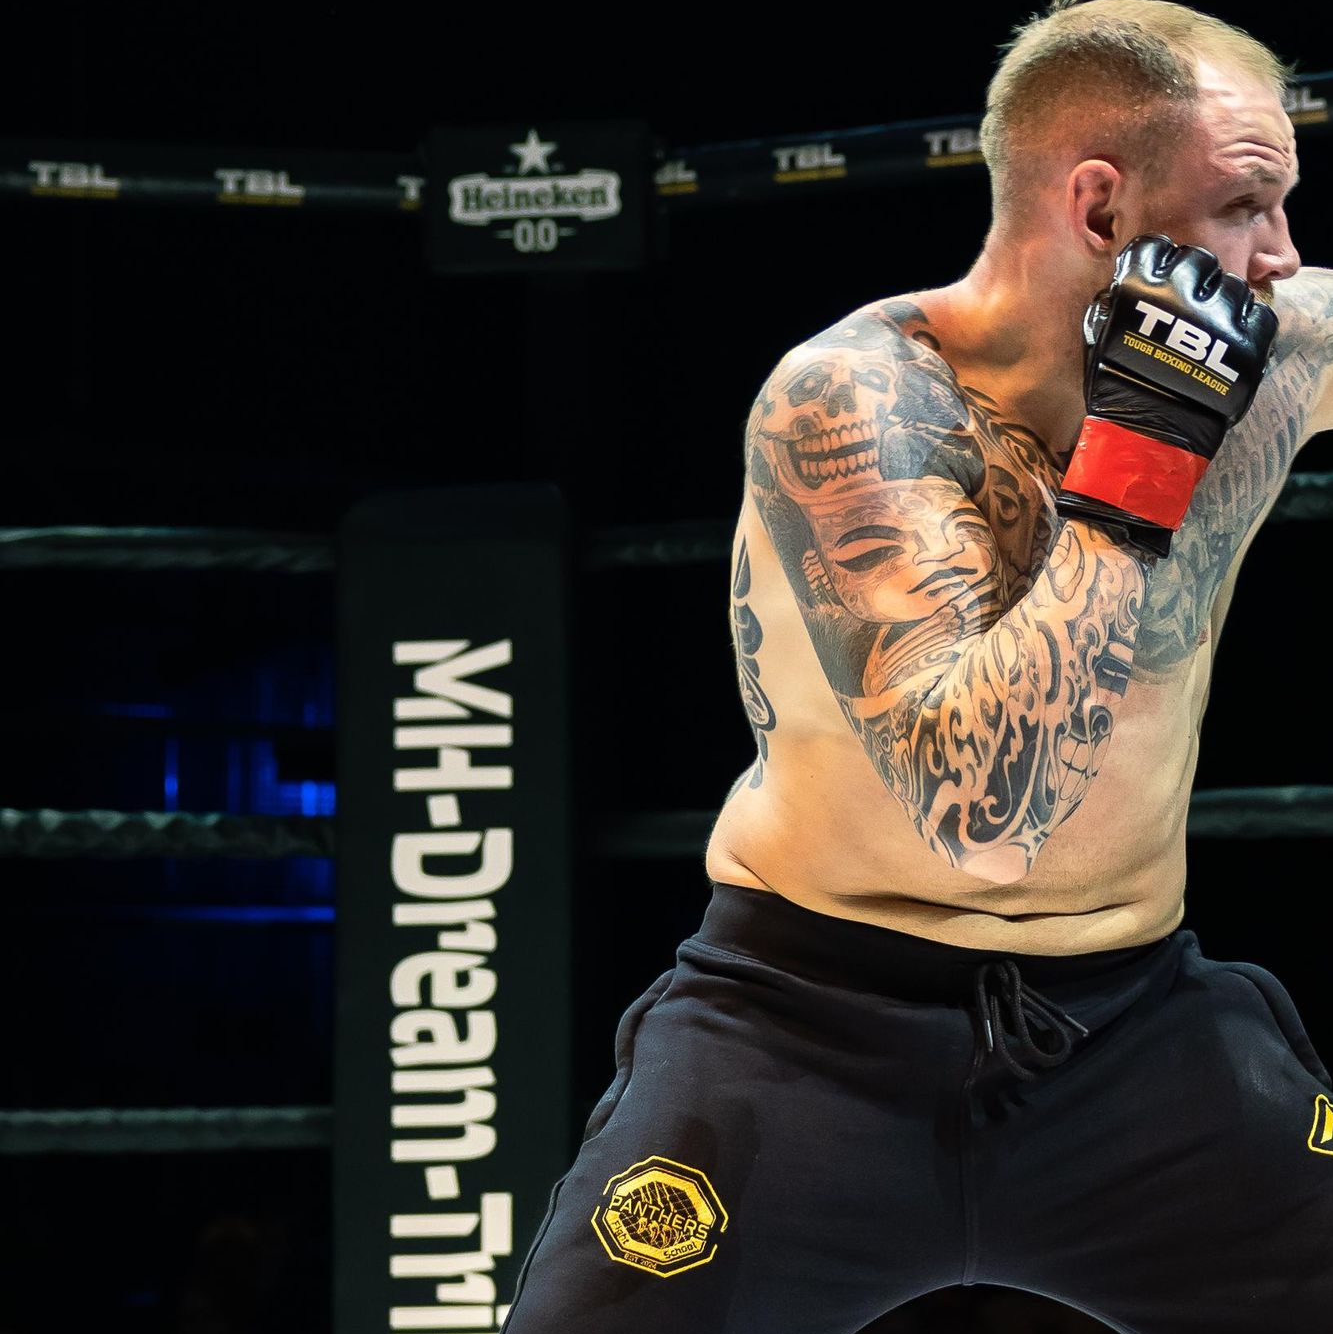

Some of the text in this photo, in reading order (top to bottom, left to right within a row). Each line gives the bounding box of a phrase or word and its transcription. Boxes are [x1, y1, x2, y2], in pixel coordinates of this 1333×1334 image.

[772, 142, 847, 172] TBL
[923, 128, 982, 157] TB
[28, 160, 120, 188] TBL
[214, 168, 306, 197] TBL
[462, 182, 608, 212] Heineken
[1135, 300, 1240, 382] TBL
[1123, 334, 1230, 396] TOUGH BOXING LEAGUE
[608, 1195, 710, 1240] PANTHERS
[612, 1220, 697, 1258] Fight School
